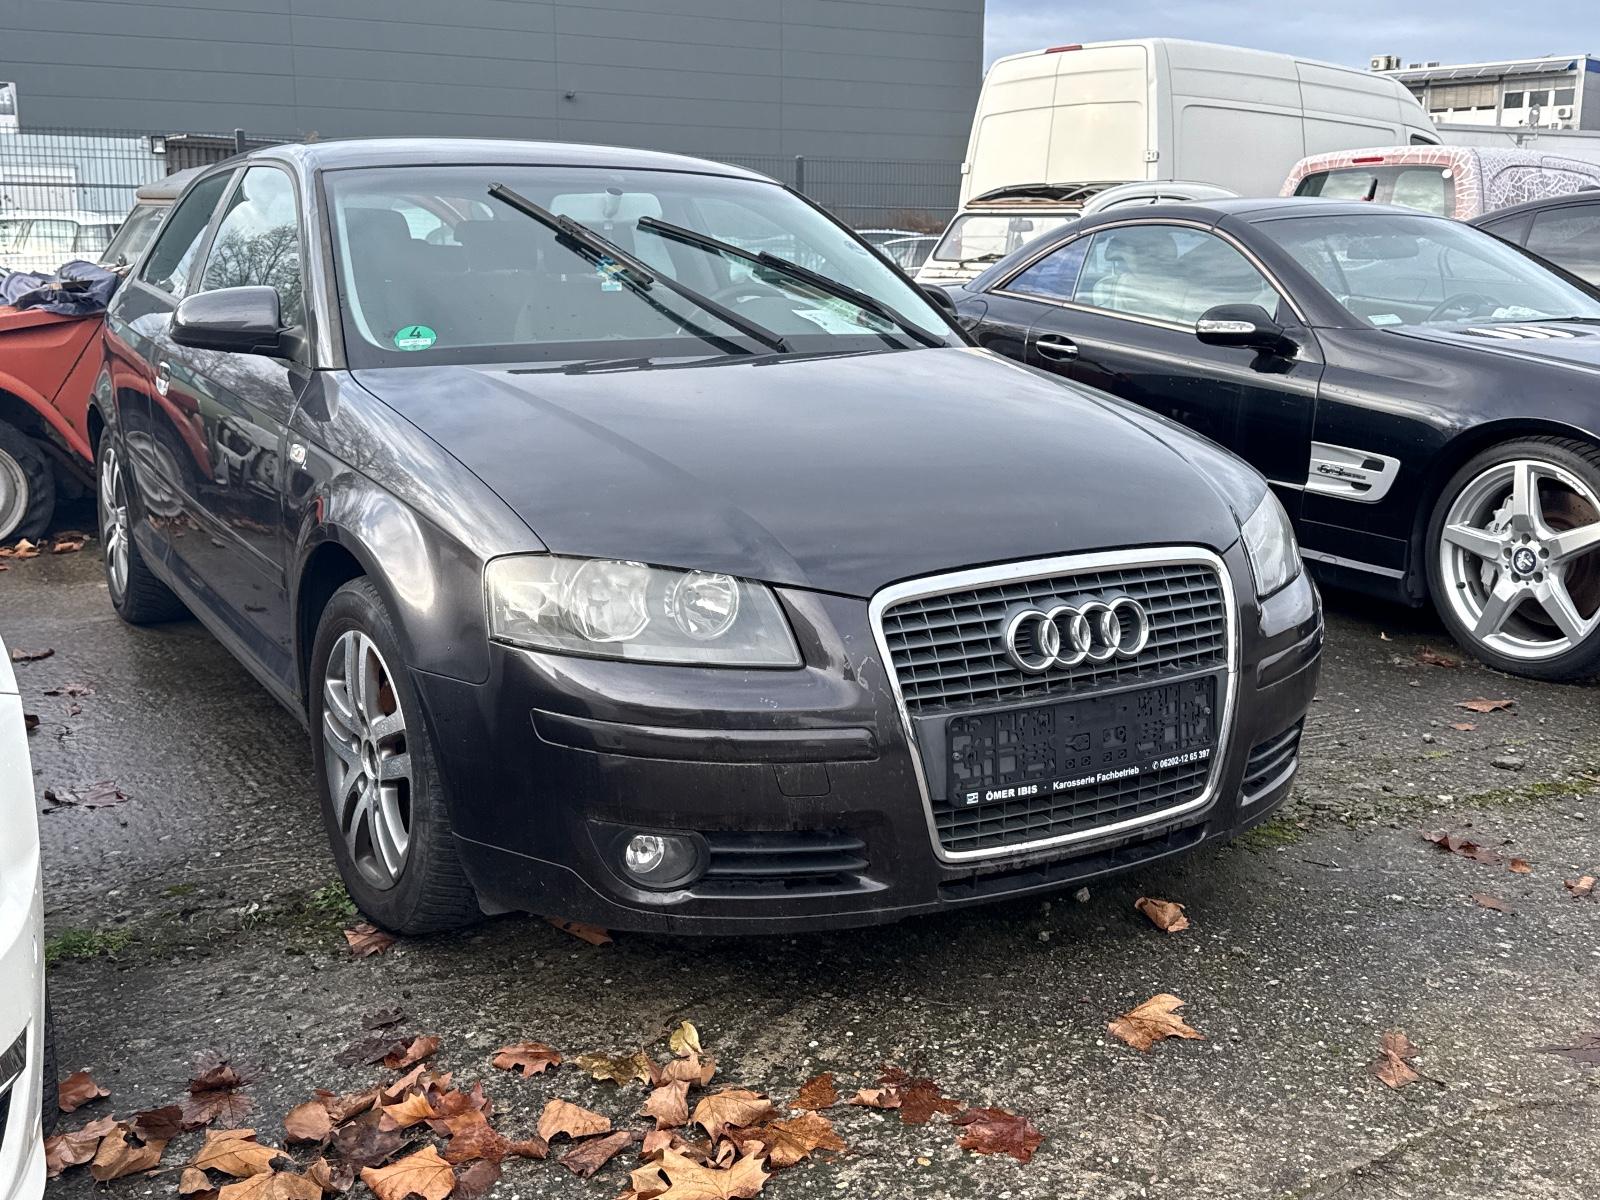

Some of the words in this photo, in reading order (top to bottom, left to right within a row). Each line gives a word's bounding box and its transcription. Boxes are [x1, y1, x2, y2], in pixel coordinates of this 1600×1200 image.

[409, 326, 422, 338] 4
[986, 788, 1015, 801] ÖMER
[1018, 785, 1038, 796] IBIS
[1053, 775, 1095, 790] Karosserie
[1097, 766, 1139, 782] Fachbetrieb
